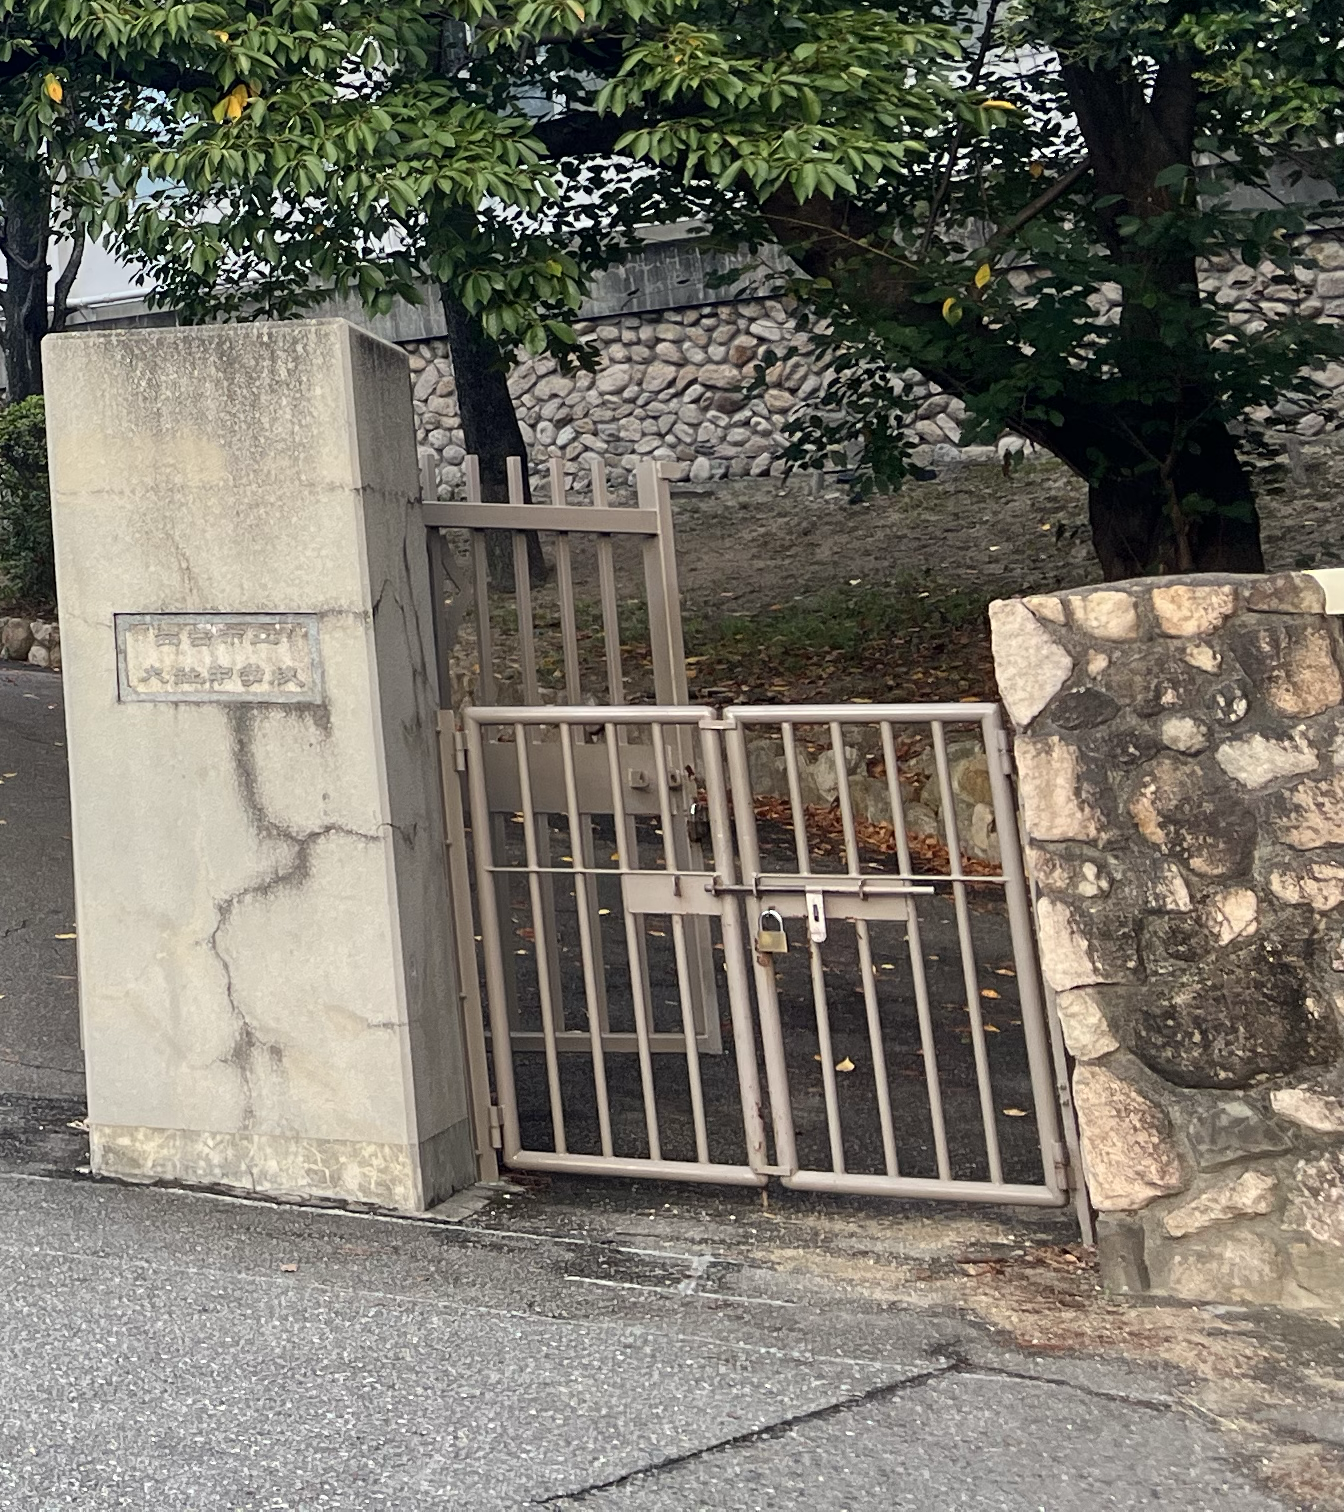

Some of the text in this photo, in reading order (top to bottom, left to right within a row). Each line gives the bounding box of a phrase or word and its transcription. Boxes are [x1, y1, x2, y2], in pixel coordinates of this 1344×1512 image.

[140, 662, 305, 687] 大社中学校
